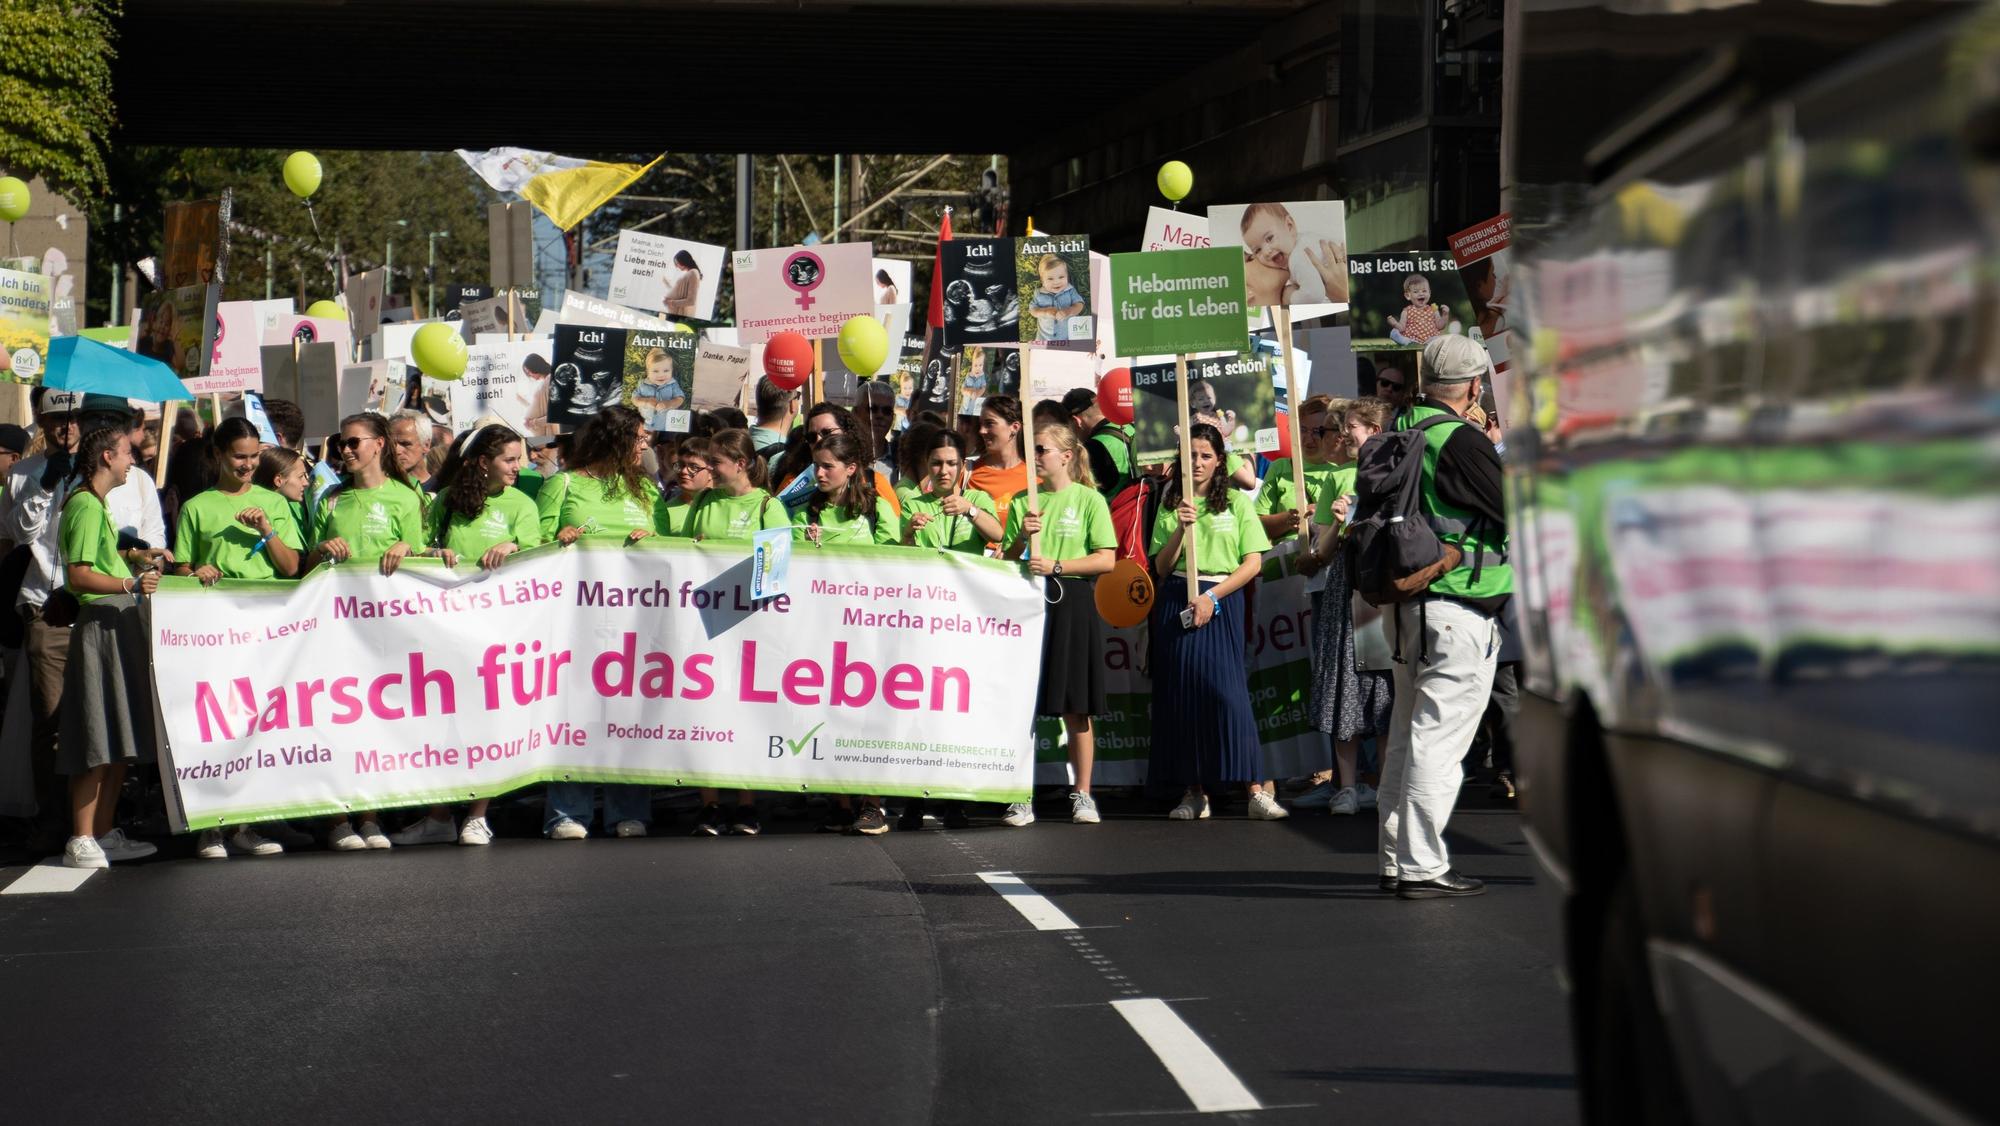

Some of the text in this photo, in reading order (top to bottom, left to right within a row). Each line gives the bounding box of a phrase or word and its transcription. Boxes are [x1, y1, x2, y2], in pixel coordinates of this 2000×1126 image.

[1454, 217, 1513, 249] ABTREIBUNG TÖT
[1461, 230, 1511, 257] UNGEBORENES
[966, 244, 993, 257] Ich!
[1022, 240, 1085, 255] Auch ich!
[624, 254, 667, 269] Liebe mich
[1350, 260, 1372, 274] Das
[1376, 258, 1415, 273] Leben
[1418, 257, 1437, 272] ist
[1, 276, 40, 293] Ich bin
[461, 288, 480, 297] Ich!
[1128, 273, 1229, 294] Hebammen
[566, 295, 585, 310] Das
[587, 301, 617, 319] Leben
[1121, 296, 1240, 320] für das Leben
[742, 315, 816, 329] Frauenrechte
[578, 331, 604, 344] Ich!
[632, 335, 693, 349] Auch ich!
[492, 374, 516, 385] mich
[1135, 357, 1267, 386] Das Leen ist schön!
[476, 389, 504, 400] auch!
[333, 592, 434, 620] Marsch
[498, 578, 563, 607] Läbe
[576, 580, 671, 608] March
[679, 581, 726, 610] for
[811, 579, 957, 602] Marcia per la Vita
[160, 628, 188, 647] Mars
[190, 632, 224, 647] voor
[266, 616, 318, 642] Leven
[842, 607, 1022, 637] Marcha pela Vida
[194, 632, 971, 743] Marsch für das Leben
[607, 723, 734, 743] Pochod za život
[355, 722, 587, 775] Marche pour la Vie
[835, 738, 928, 752] BUNDESVERBAND
[929, 742, 999, 758] LEBENSRECHT
[225, 754, 252, 780] por
[257, 749, 276, 769] la
[280, 744, 332, 767] Vida
[834, 752, 1015, 773] www.bundesverband-lebensrecht.de
